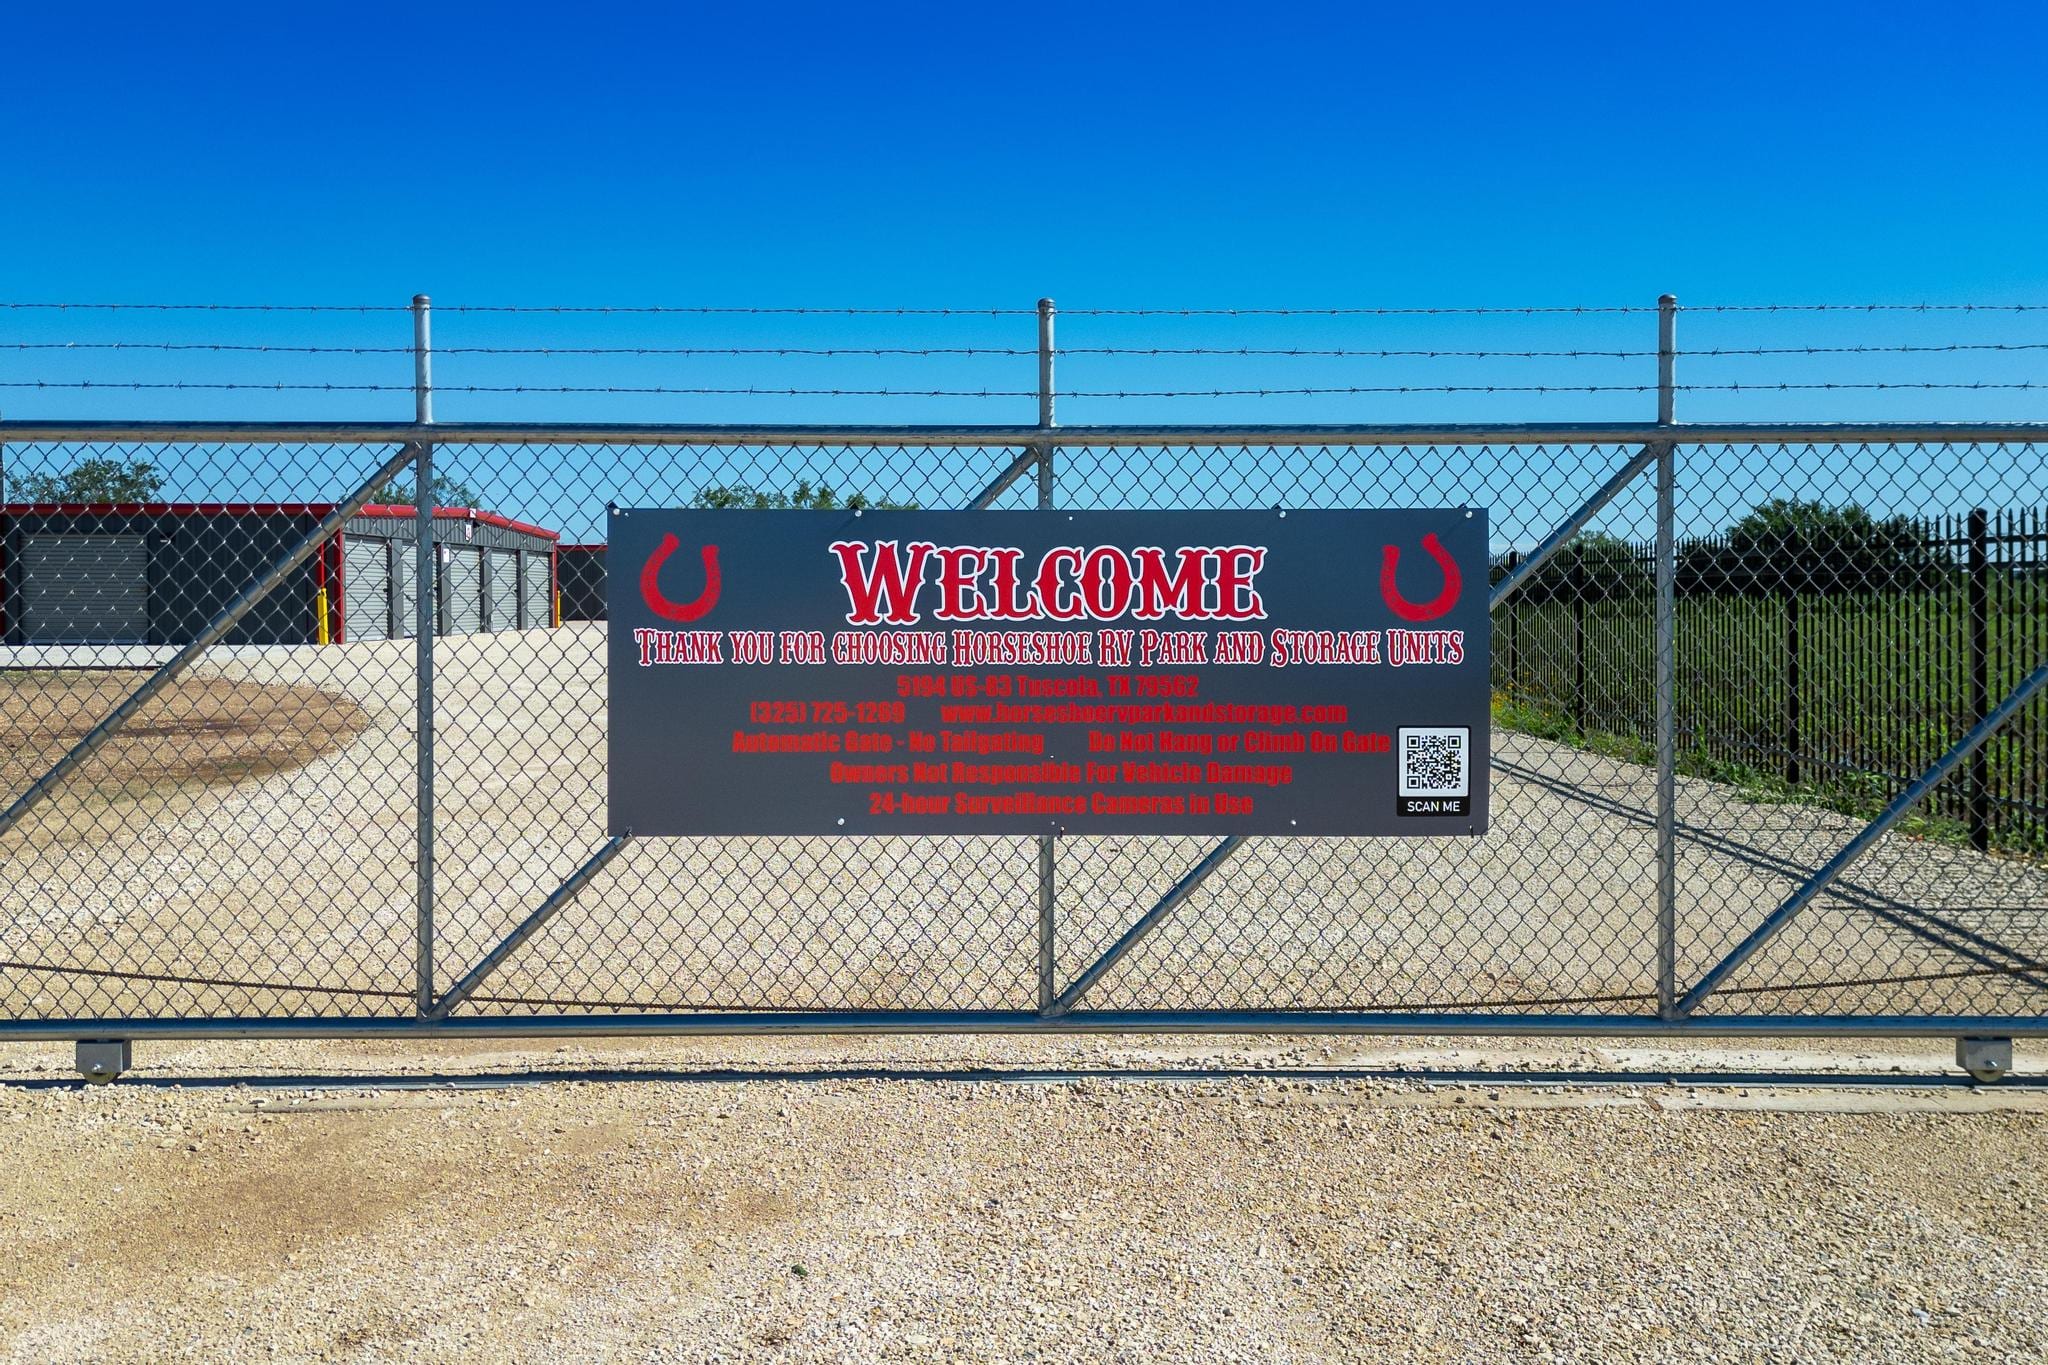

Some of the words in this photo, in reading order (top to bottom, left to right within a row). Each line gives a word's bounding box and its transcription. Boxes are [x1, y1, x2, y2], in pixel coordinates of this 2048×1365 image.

[828, 540, 1268, 626] WELCOME
[633, 628, 724, 667] THANK
[728, 630, 775, 665] YOU
[779, 631, 826, 664] FOR
[831, 628, 947, 665] CHOOSING
[951, 629, 1093, 667] HORSESHOE
[1097, 629, 1135, 667] RV
[1139, 629, 1208, 667] PARK
[1213, 631, 1266, 664] AND
[1270, 628, 1381, 667] STORAGE
[1386, 629, 1464, 667] UNITS
[897, 675, 946, 697] 5194
[950, 675, 1012, 697] US-83
[1017, 675, 1103, 699] Tuscola,
[1107, 675, 1131, 696] TX
[1135, 675, 1199, 697] 79562
[750, 701, 806, 723] (325)
[941, 702, 1347, 726] www.horseshoervparkandstorage.com
[733, 731, 840, 752] Automatic
[845, 730, 892, 752] Gate
[909, 731, 936, 752] No
[940, 730, 1044, 755] Tailgating
[1088, 730, 1116, 752] Do
[1120, 731, 1154, 752] Not
[1159, 731, 1212, 755] Hang
[1217, 734, 1240, 752] or
[1244, 730, 1305, 753] Climb
[1310, 731, 1338, 752] On
[1342, 731, 1391, 753] Gate
[830, 761, 909, 783] Owners
[913, 762, 948, 783] Not
[952, 761, 1081, 786] Responsible
[1086, 762, 1118, 783] For
[1122, 761, 1202, 783] Vehicle
[1206, 761, 1292, 786] Damage
[869, 792, 951, 814] 24-hour
[955, 792, 1087, 815] Surveillance
[1091, 792, 1185, 814] Cameras
[1214, 793, 1253, 814] Use
[1407, 800, 1440, 812] SCAN
[1443, 800, 1461, 812] ME
